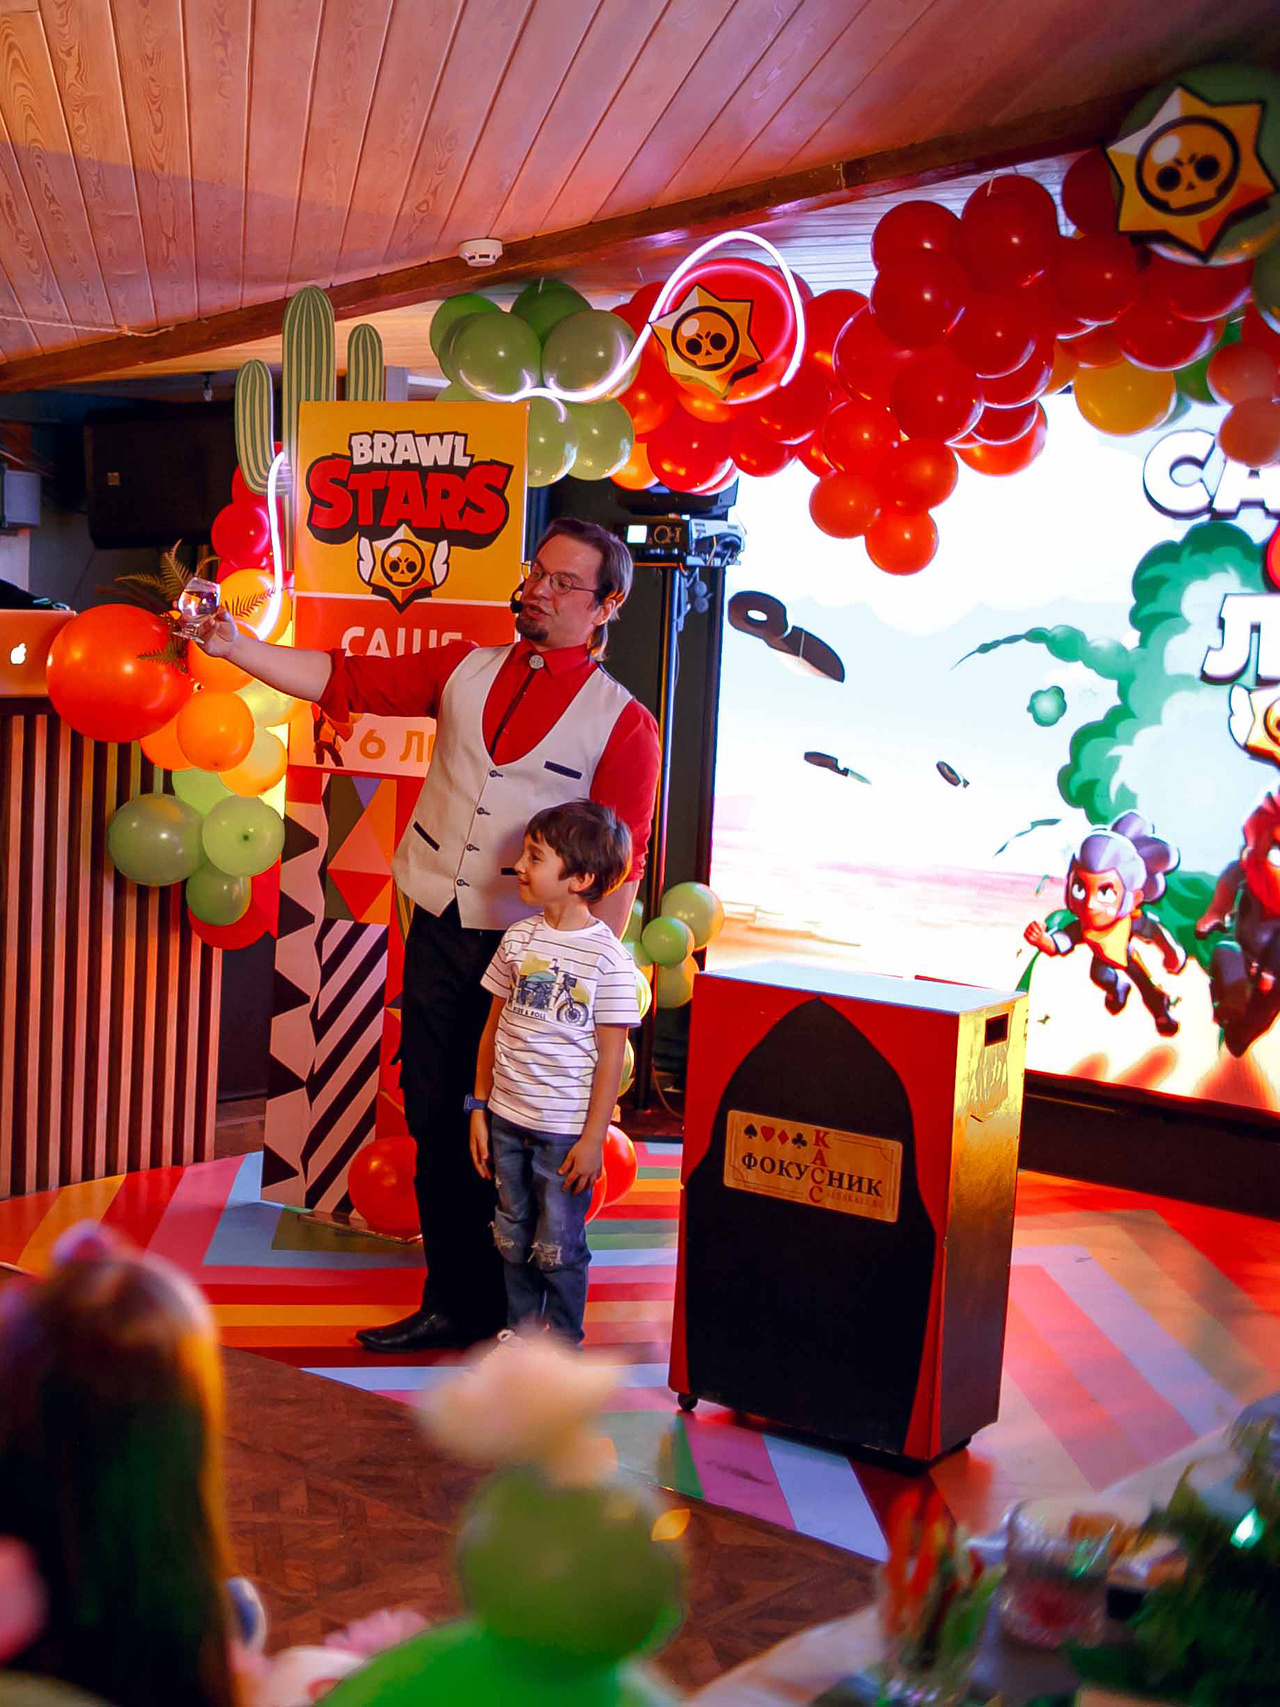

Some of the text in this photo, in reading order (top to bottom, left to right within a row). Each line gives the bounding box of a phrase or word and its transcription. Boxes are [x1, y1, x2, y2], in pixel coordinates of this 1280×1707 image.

[350, 433, 473, 467] BRAWL
[309, 458, 510, 538] STARS
[359, 728, 387, 760] 6
[741, 1152, 884, 1198] ФОКУСНИК
